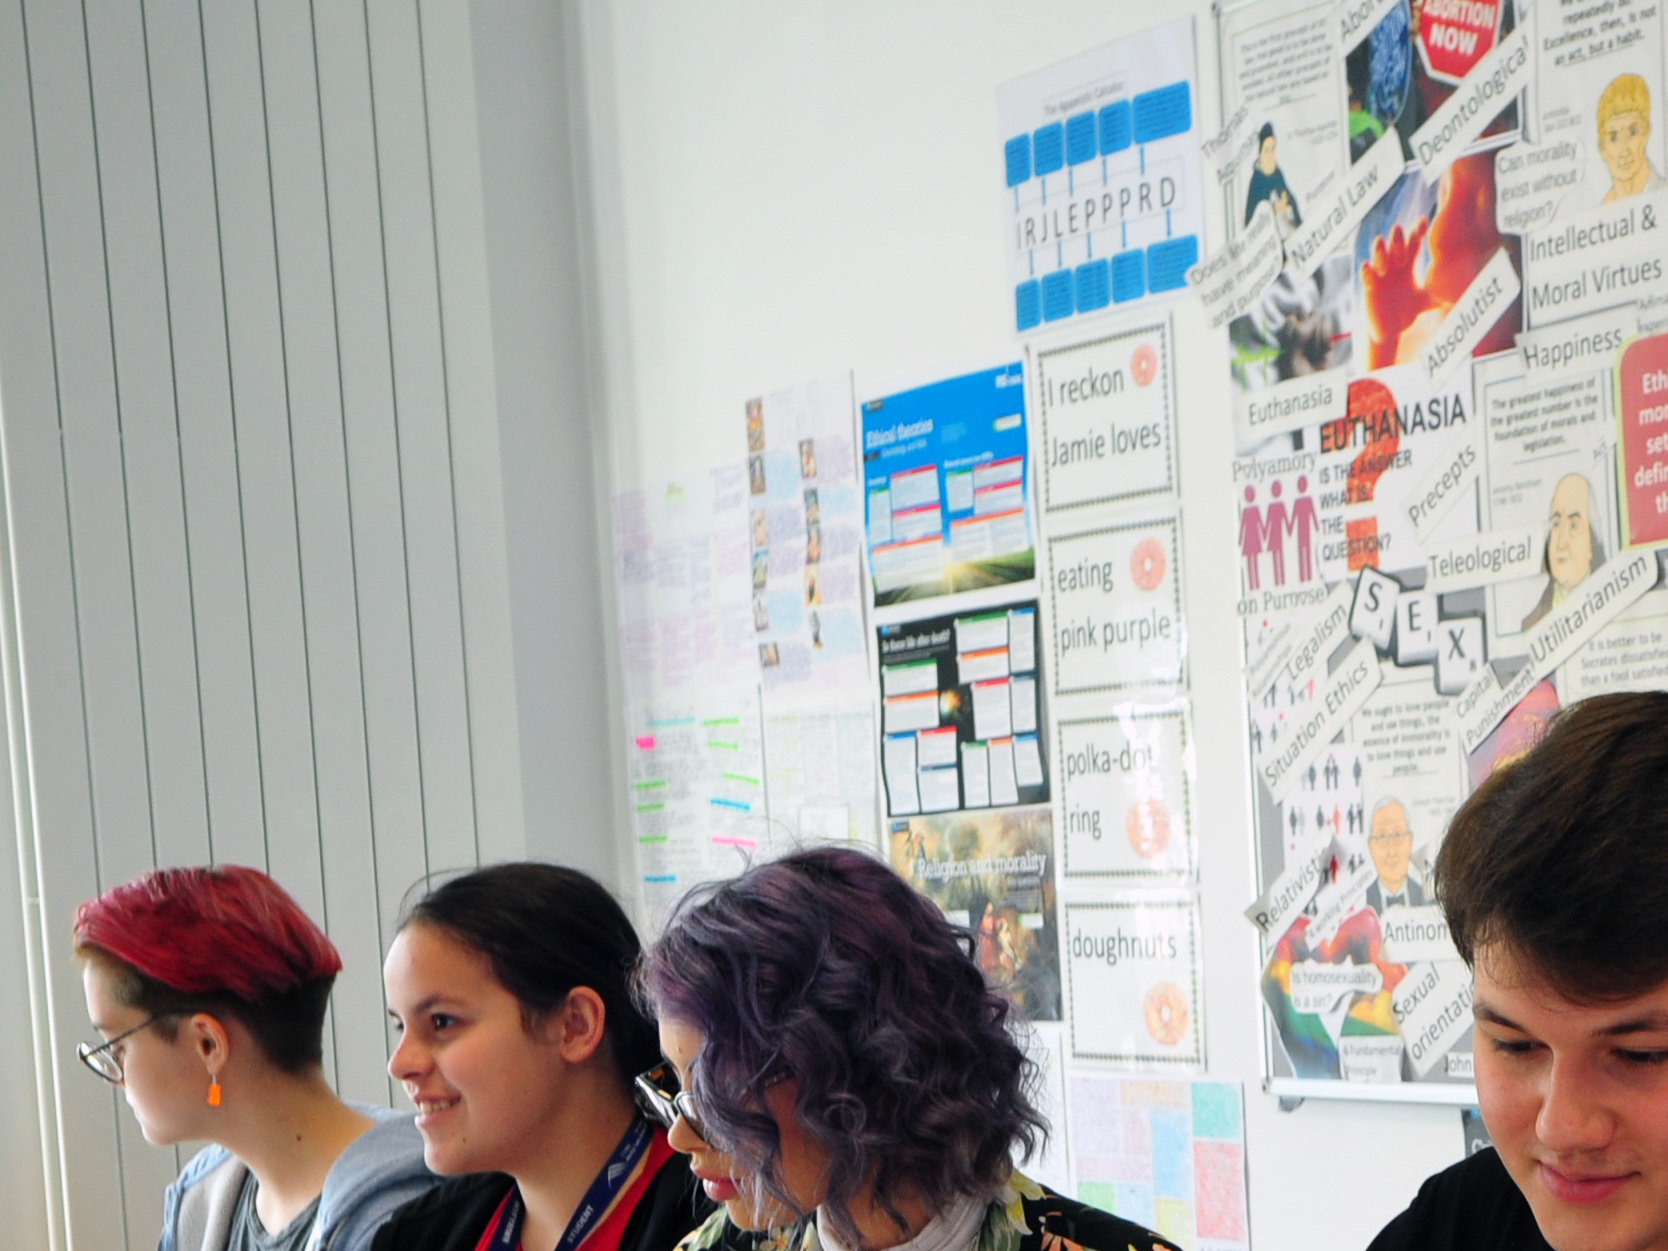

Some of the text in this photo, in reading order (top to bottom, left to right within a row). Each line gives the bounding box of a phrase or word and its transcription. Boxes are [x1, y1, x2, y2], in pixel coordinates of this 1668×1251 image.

[1430, 23, 1477, 56] NOW
[1292, 167, 1379, 269] Natural Law
[1531, 209, 1635, 262] Intellectual
[1532, 259, 1662, 309] Moral Virtues
[1427, 276, 1503, 376] Absolutist
[1524, 328, 1623, 369] Happiness
[1060, 367, 1124, 406] reckon
[1248, 386, 1333, 426] Euthanasia
[1051, 422, 1161, 467] Jamie loves
[1319, 394, 1467, 454] EUTHANASIA
[1408, 446, 1477, 528] Precepts
[1057, 556, 1113, 595] eating
[1429, 536, 1531, 580] Teleological
[1529, 553, 1649, 664] Utilitarianism
[1061, 608, 1171, 657] pink purple
[1285, 603, 1348, 682] Legalism
[1266, 660, 1369, 788] Situation Ethics
[1070, 807, 1101, 839] ring
[917, 859, 968, 882] Religion
[996, 851, 1048, 874] morality
[1072, 928, 1178, 966] doughnuts
[567, 1203, 594, 1244] STUDENT
